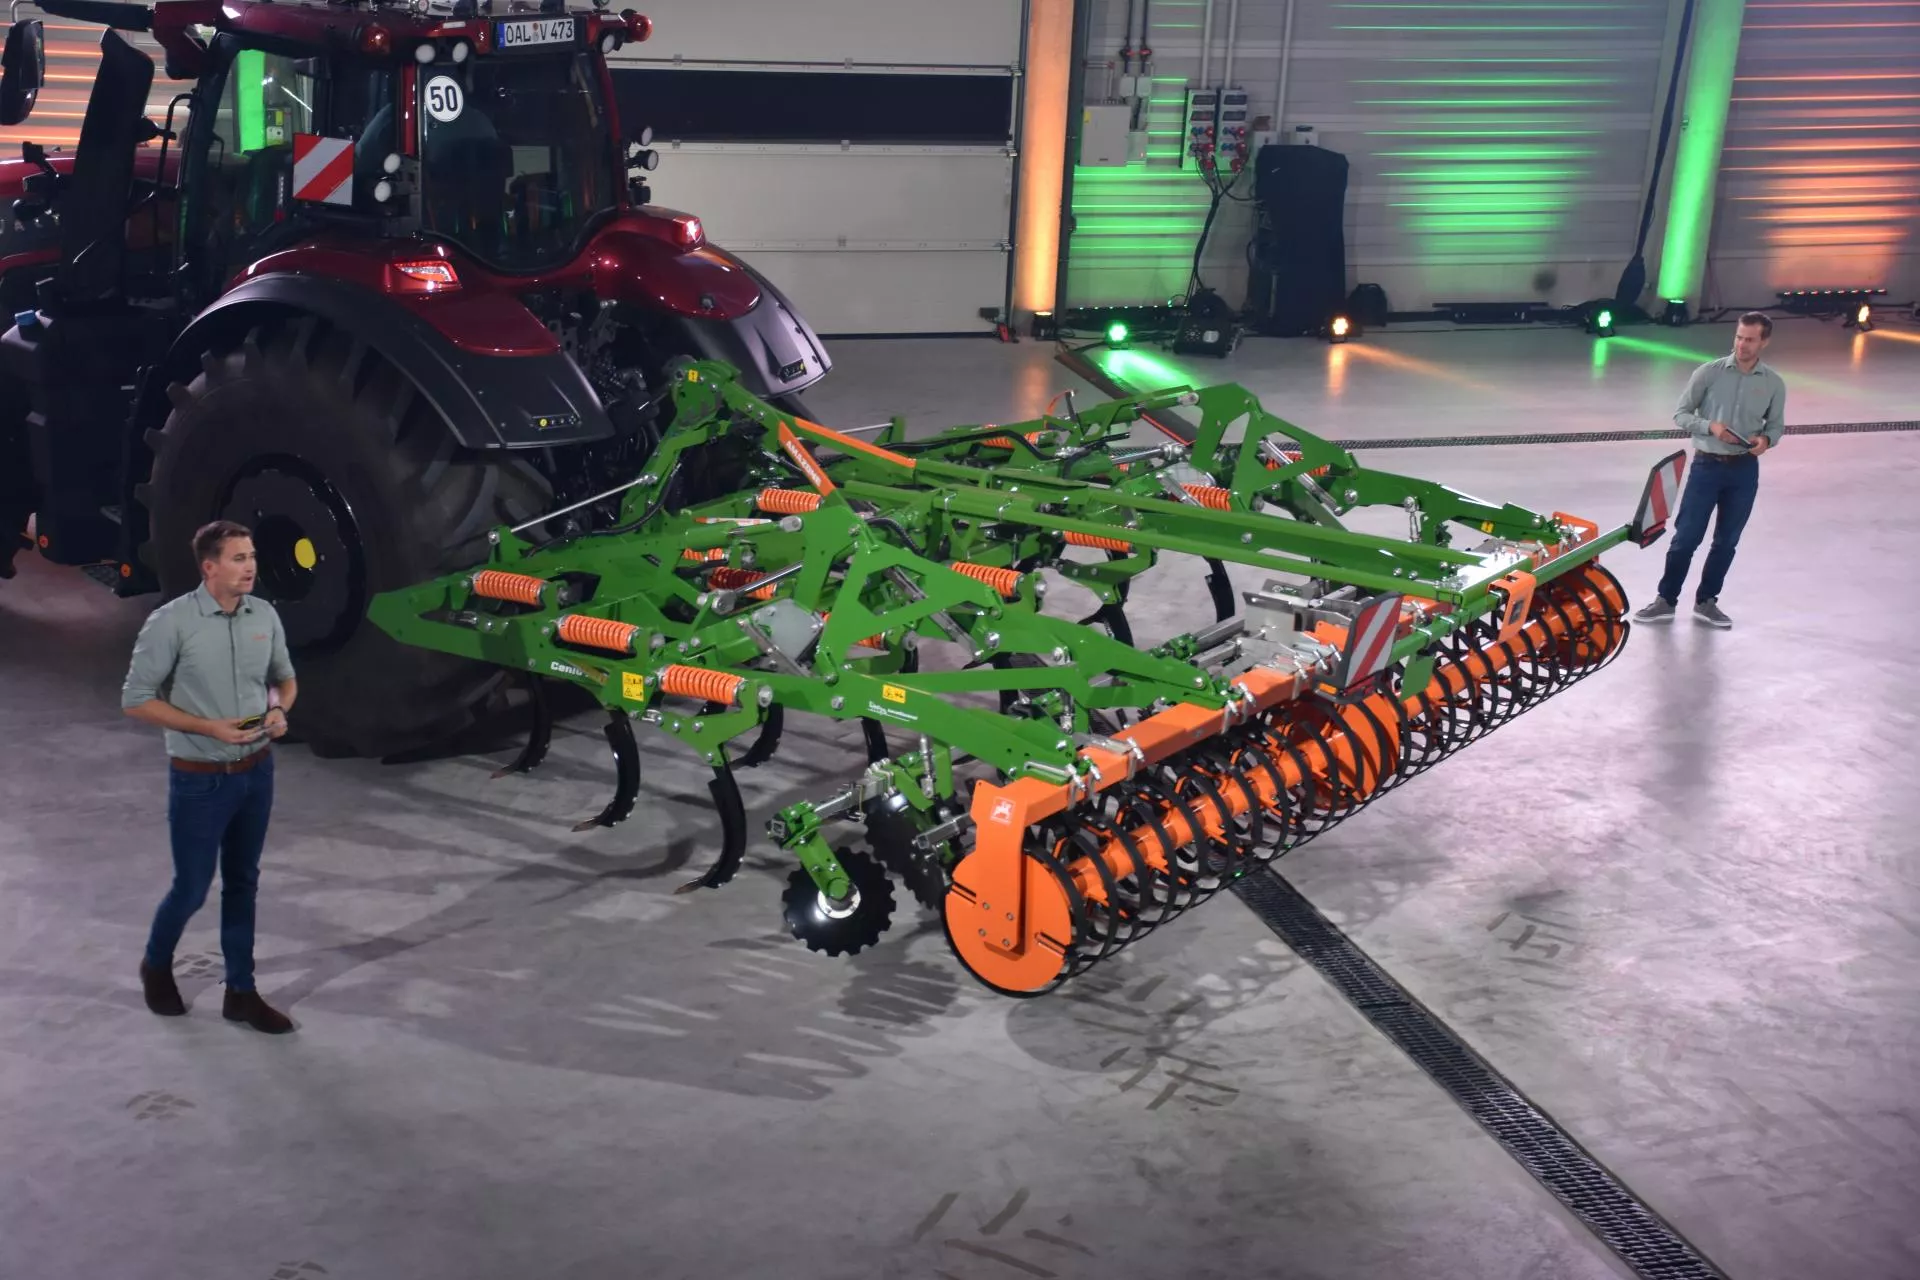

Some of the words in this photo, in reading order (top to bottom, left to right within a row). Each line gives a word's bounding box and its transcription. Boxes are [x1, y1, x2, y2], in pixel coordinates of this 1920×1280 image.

[506, 24, 531, 43] OAL
[540, 23, 548, 41] V
[550, 21, 573, 39] 473
[430, 85, 458, 112] 50
[786, 440, 822, 487] AMAZONE
